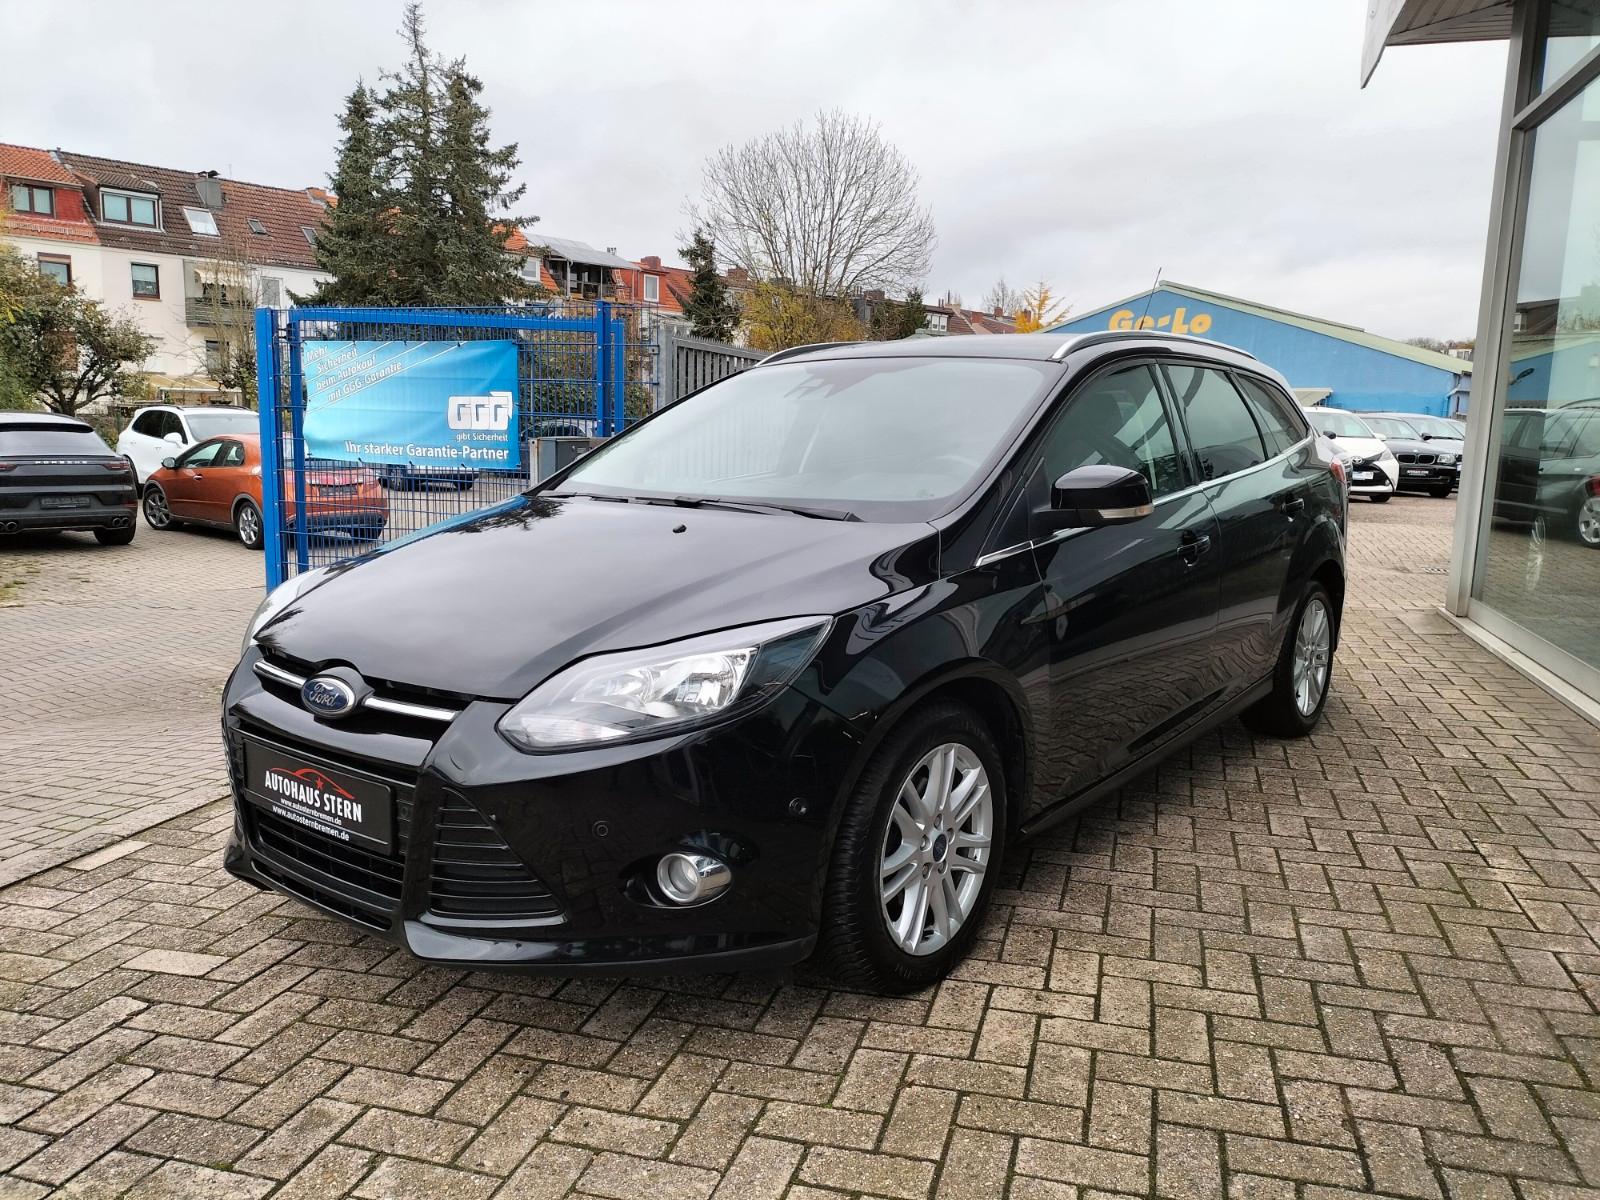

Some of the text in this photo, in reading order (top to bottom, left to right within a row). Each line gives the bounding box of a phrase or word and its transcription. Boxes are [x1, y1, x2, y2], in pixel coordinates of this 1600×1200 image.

[1109, 307, 1212, 335] Ge-Lo
[306, 345, 328, 362] Mehr
[317, 347, 358, 374] Sicherheit
[315, 353, 376, 391] beim Autokauf
[328, 388, 342, 402] mit
[345, 440, 509, 460] Ihr starker Garantie-Partner
[456, 433, 508, 442] gibt Sicherheit
[309, 681, 337, 706] Ford
[264, 770, 362, 823] AUTOHAUS STERN
[272, 805, 350, 841] www.autosternbremen.de
